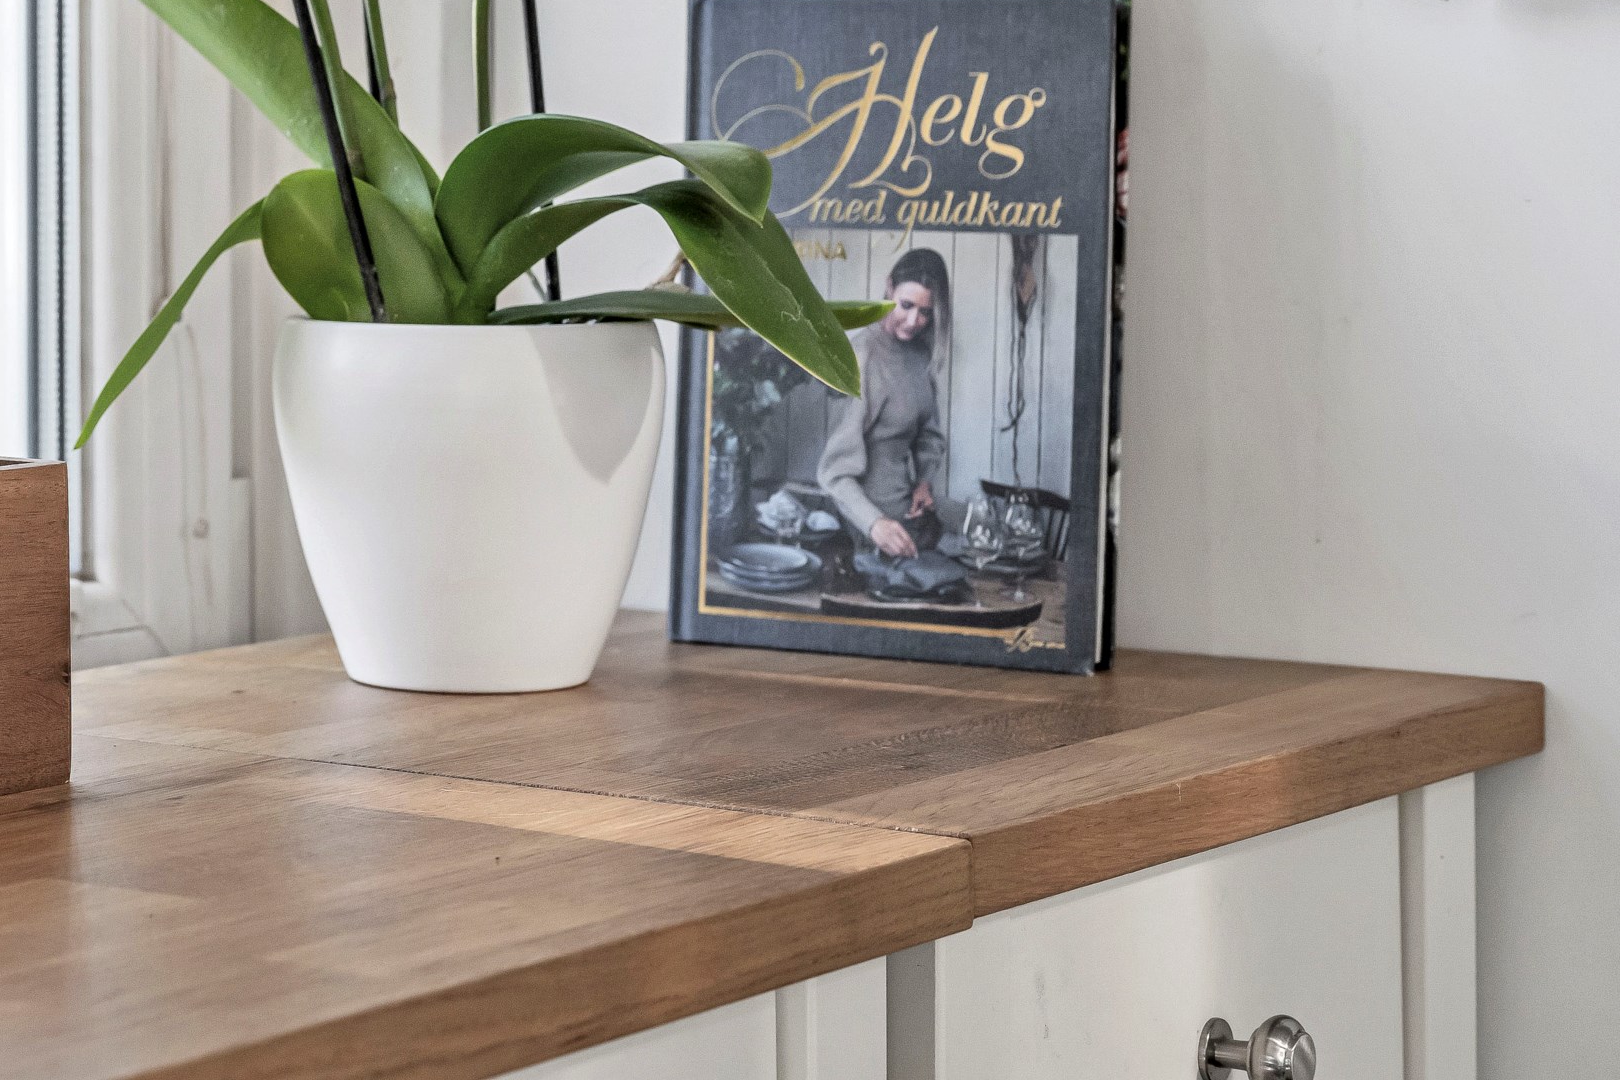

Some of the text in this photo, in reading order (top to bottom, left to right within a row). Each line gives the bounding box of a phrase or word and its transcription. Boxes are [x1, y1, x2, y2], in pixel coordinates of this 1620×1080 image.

[712, 25, 1047, 218] Helg
[809, 190, 1063, 251] med guldkant
